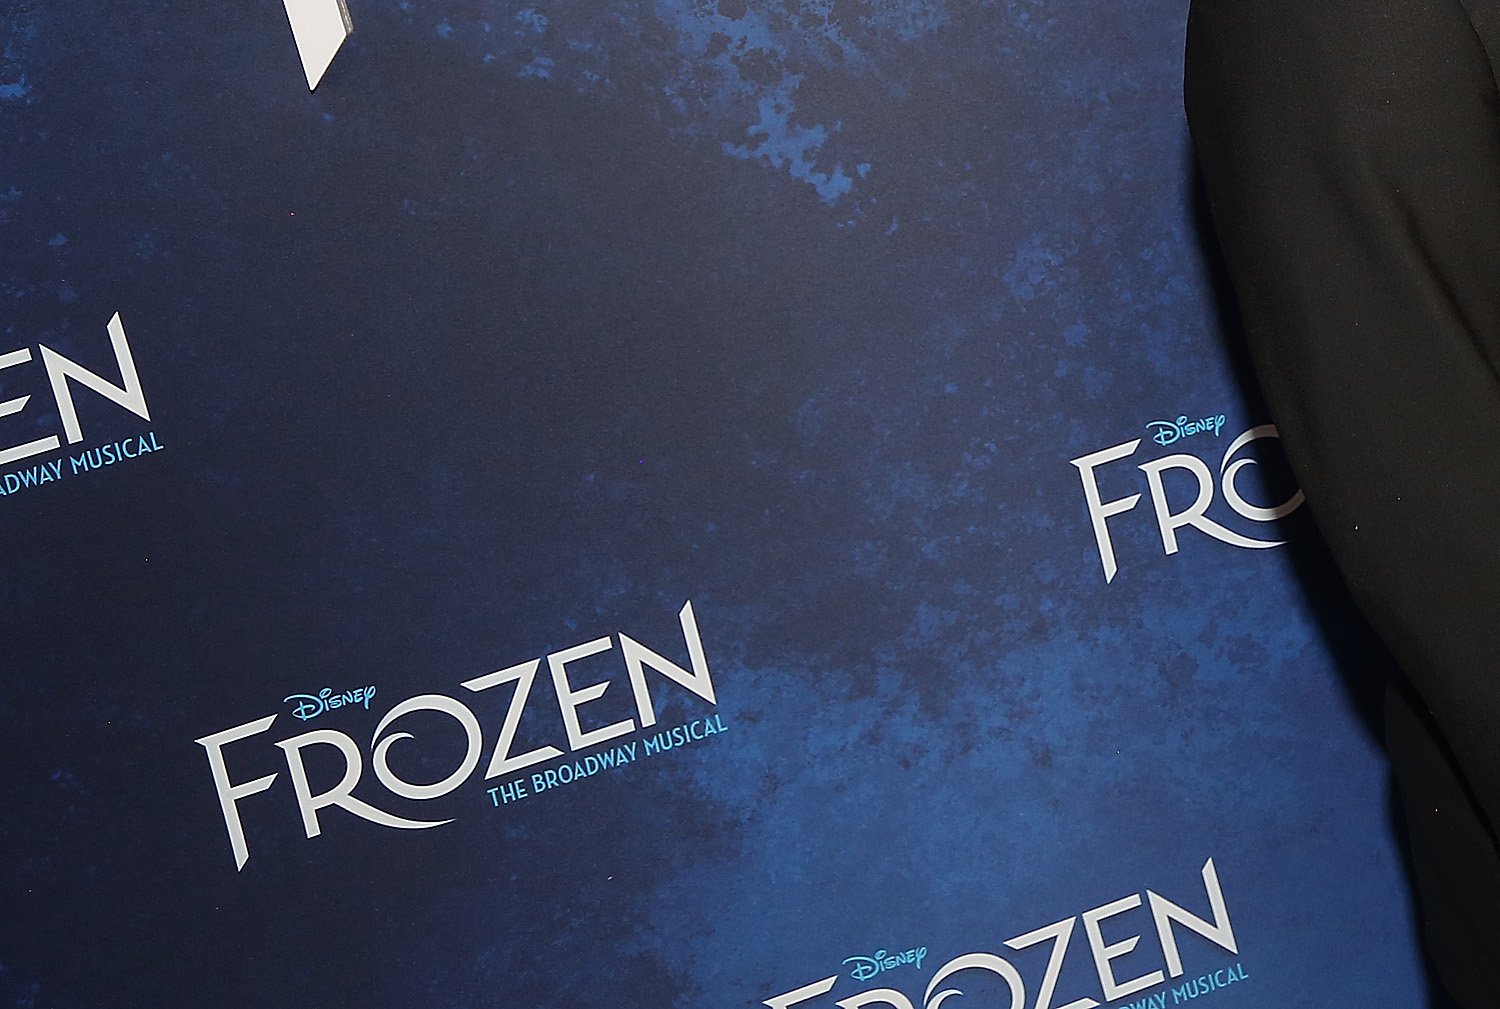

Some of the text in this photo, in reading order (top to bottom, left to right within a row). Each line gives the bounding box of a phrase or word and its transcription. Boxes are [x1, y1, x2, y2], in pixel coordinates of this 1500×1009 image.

[70, 432, 164, 474] MUSICAL
[194, 600, 718, 871] FROZEN
[487, 714, 729, 807] THE BROADWAY MUSICAL
[1173, 963, 1250, 1005] MUSICAL
